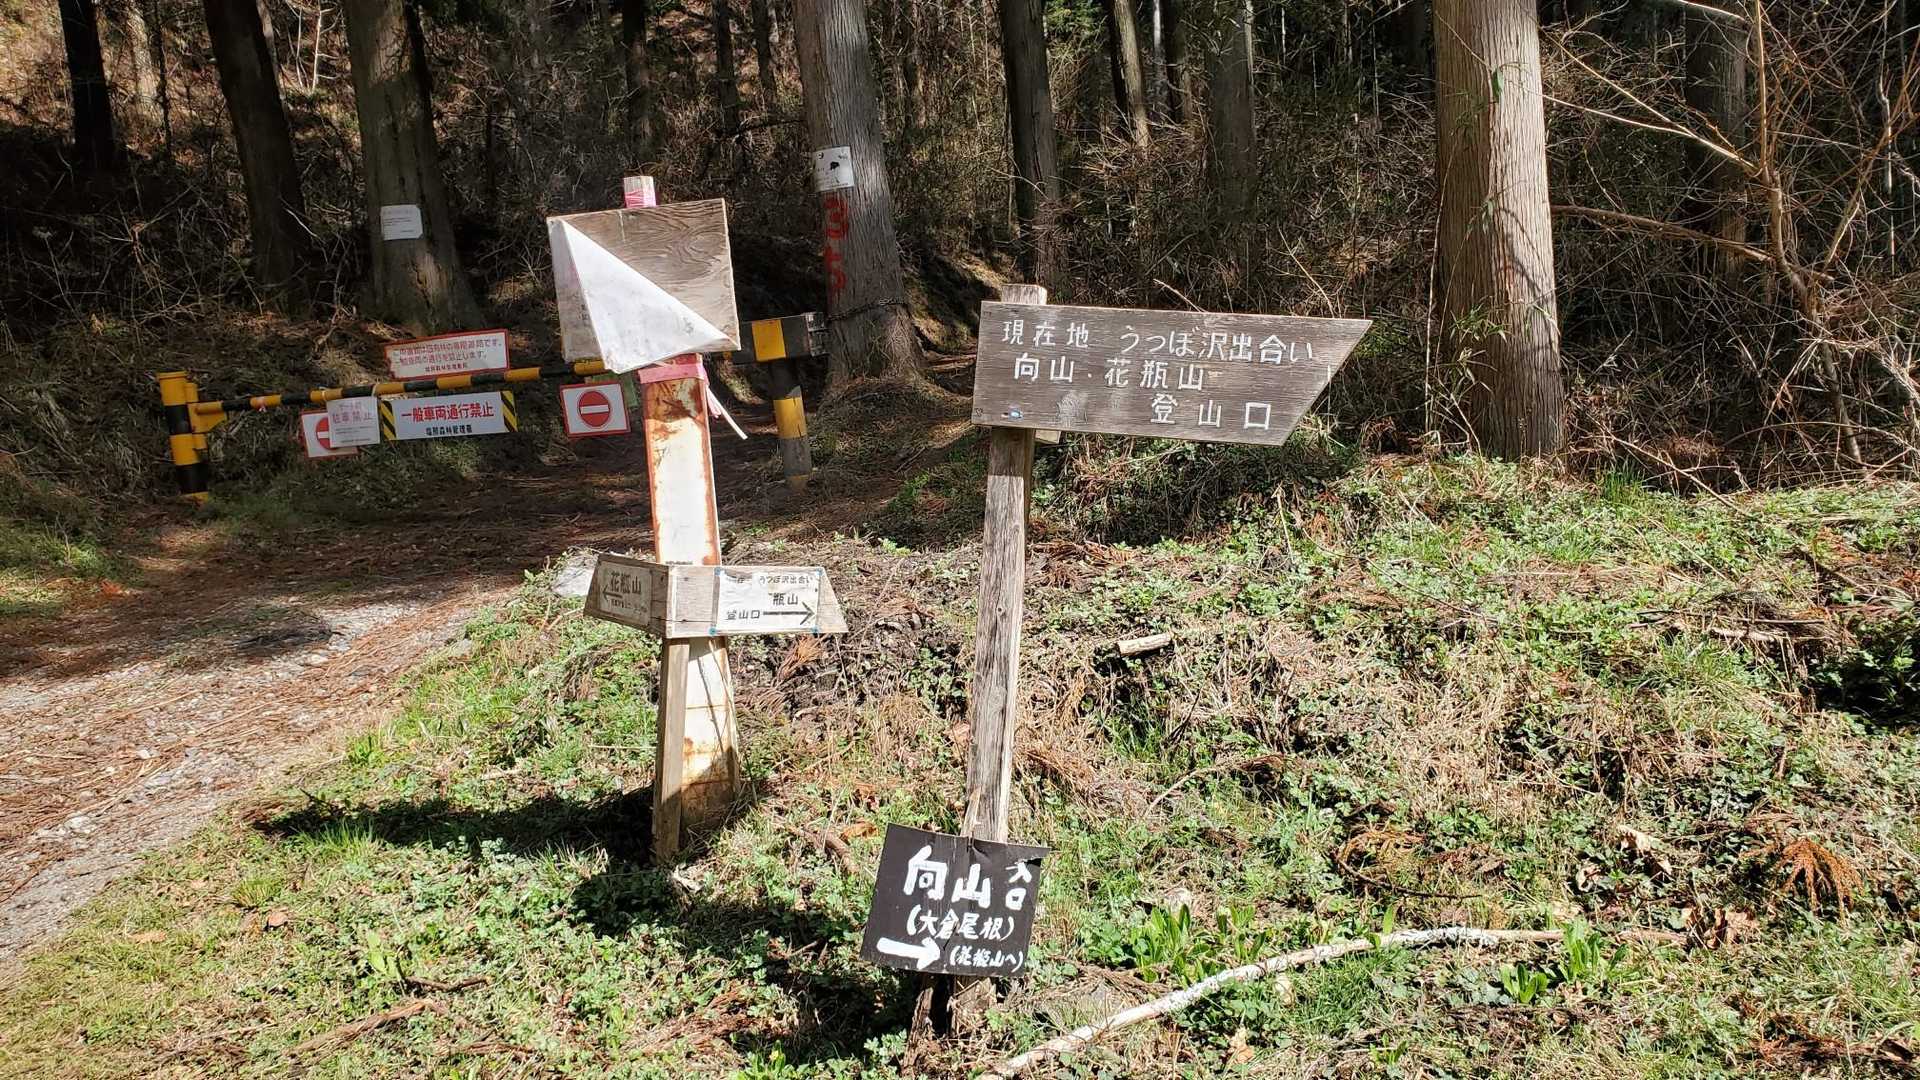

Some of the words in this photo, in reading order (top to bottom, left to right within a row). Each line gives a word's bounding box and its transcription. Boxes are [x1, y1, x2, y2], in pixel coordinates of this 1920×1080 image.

[1001, 319, 1089, 349] 現在地
[401, 401, 495, 423] 一般車両通行禁止
[1149, 393, 1272, 430] 登山口
